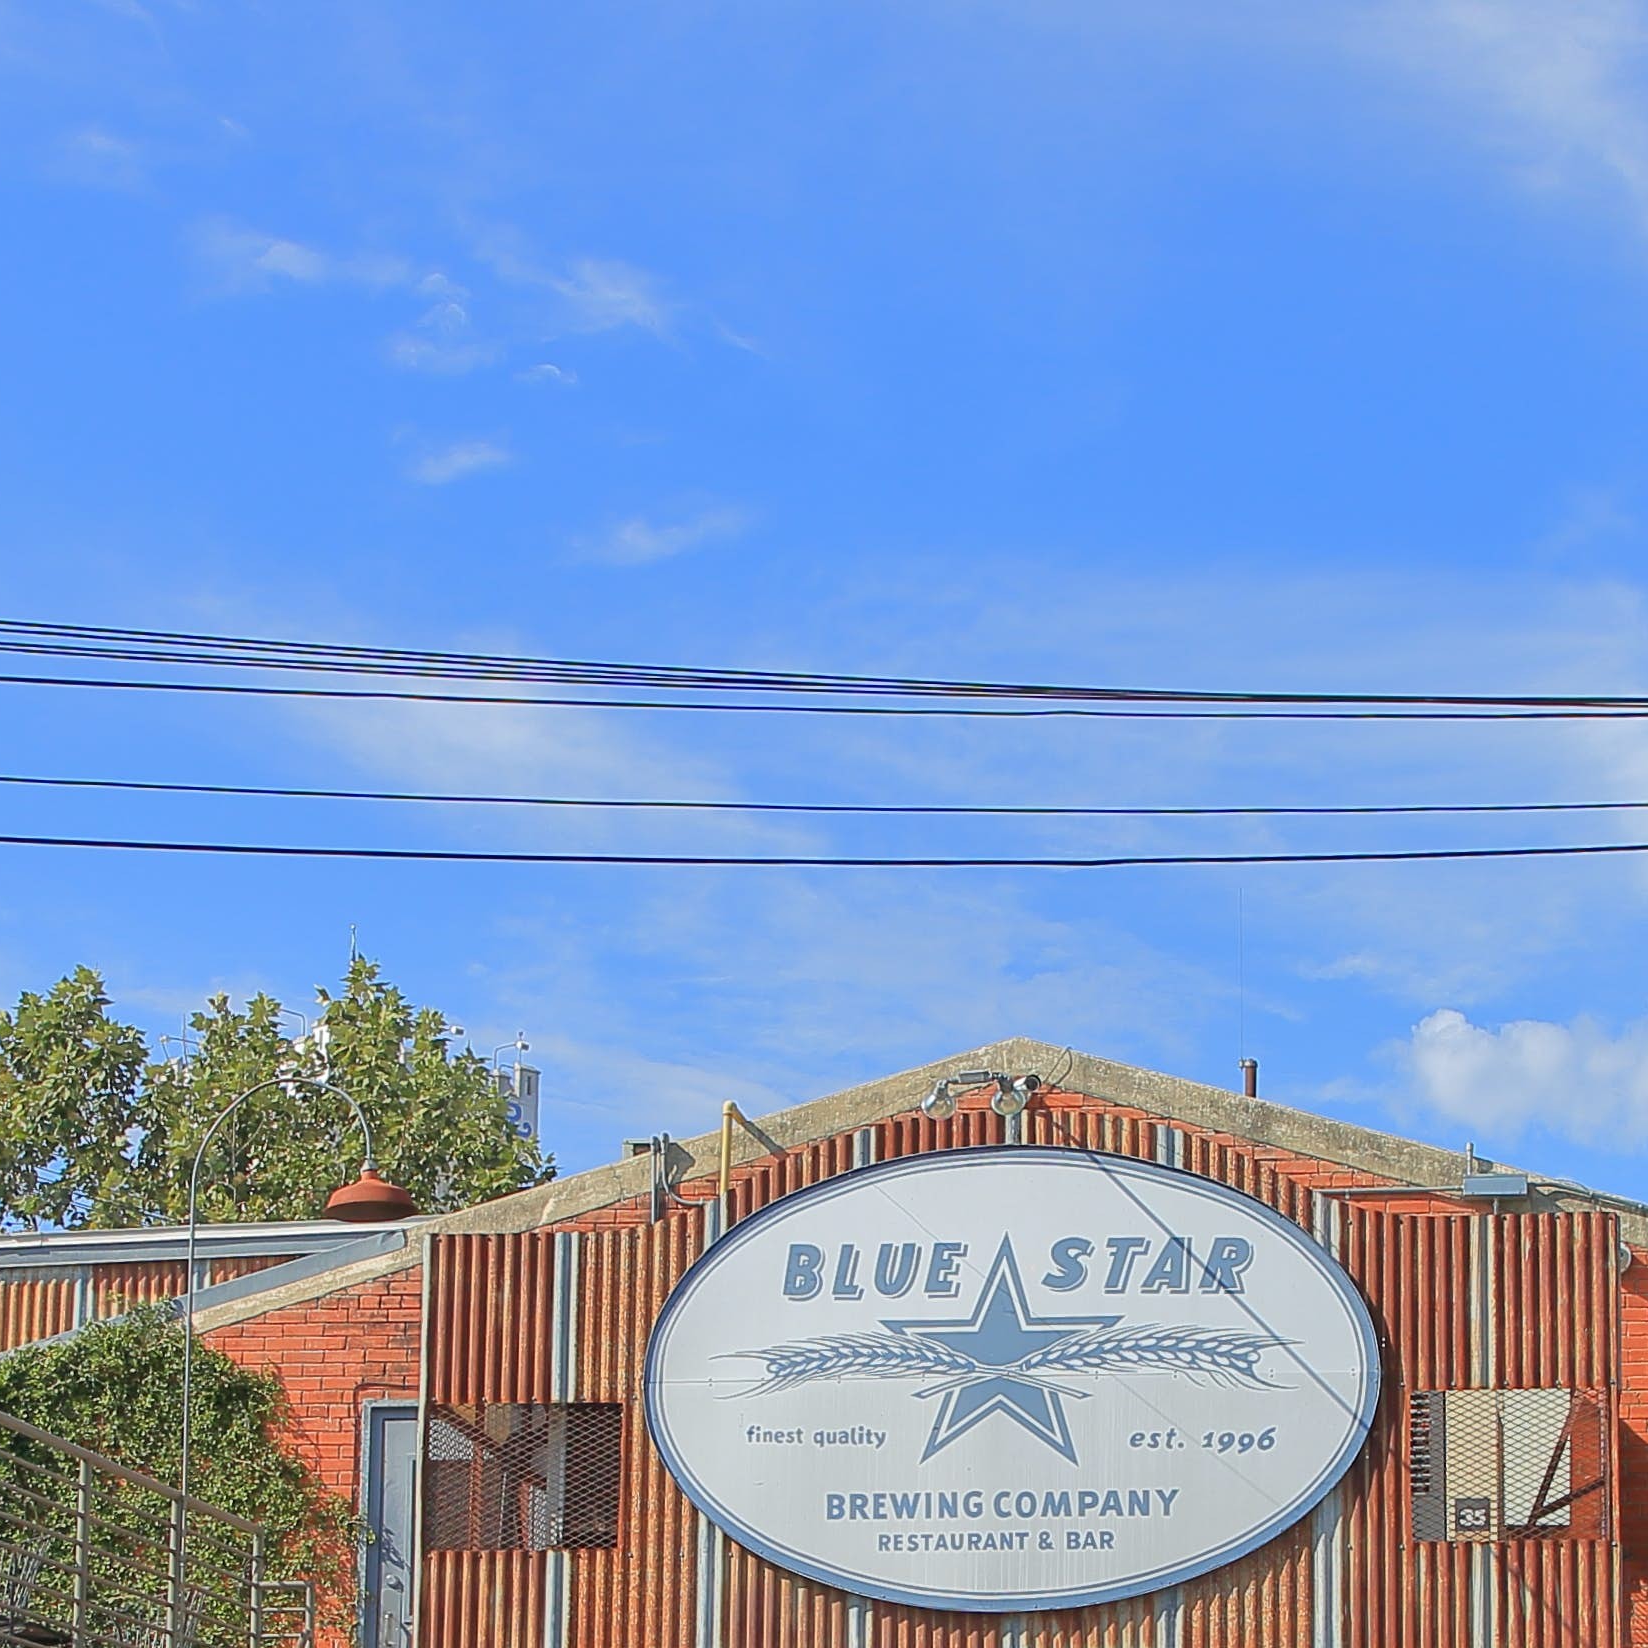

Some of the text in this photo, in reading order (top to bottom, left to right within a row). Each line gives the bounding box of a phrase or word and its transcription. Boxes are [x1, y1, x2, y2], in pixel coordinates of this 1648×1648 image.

[782, 1236, 1254, 1300] BLUE STAR
[746, 1425, 887, 1449] finest quality
[1128, 1426, 1278, 1455] est. 1996
[825, 1488, 1181, 1522] BREWING COMPANY
[877, 1530, 1115, 1552] RESTAURANT & BAR
